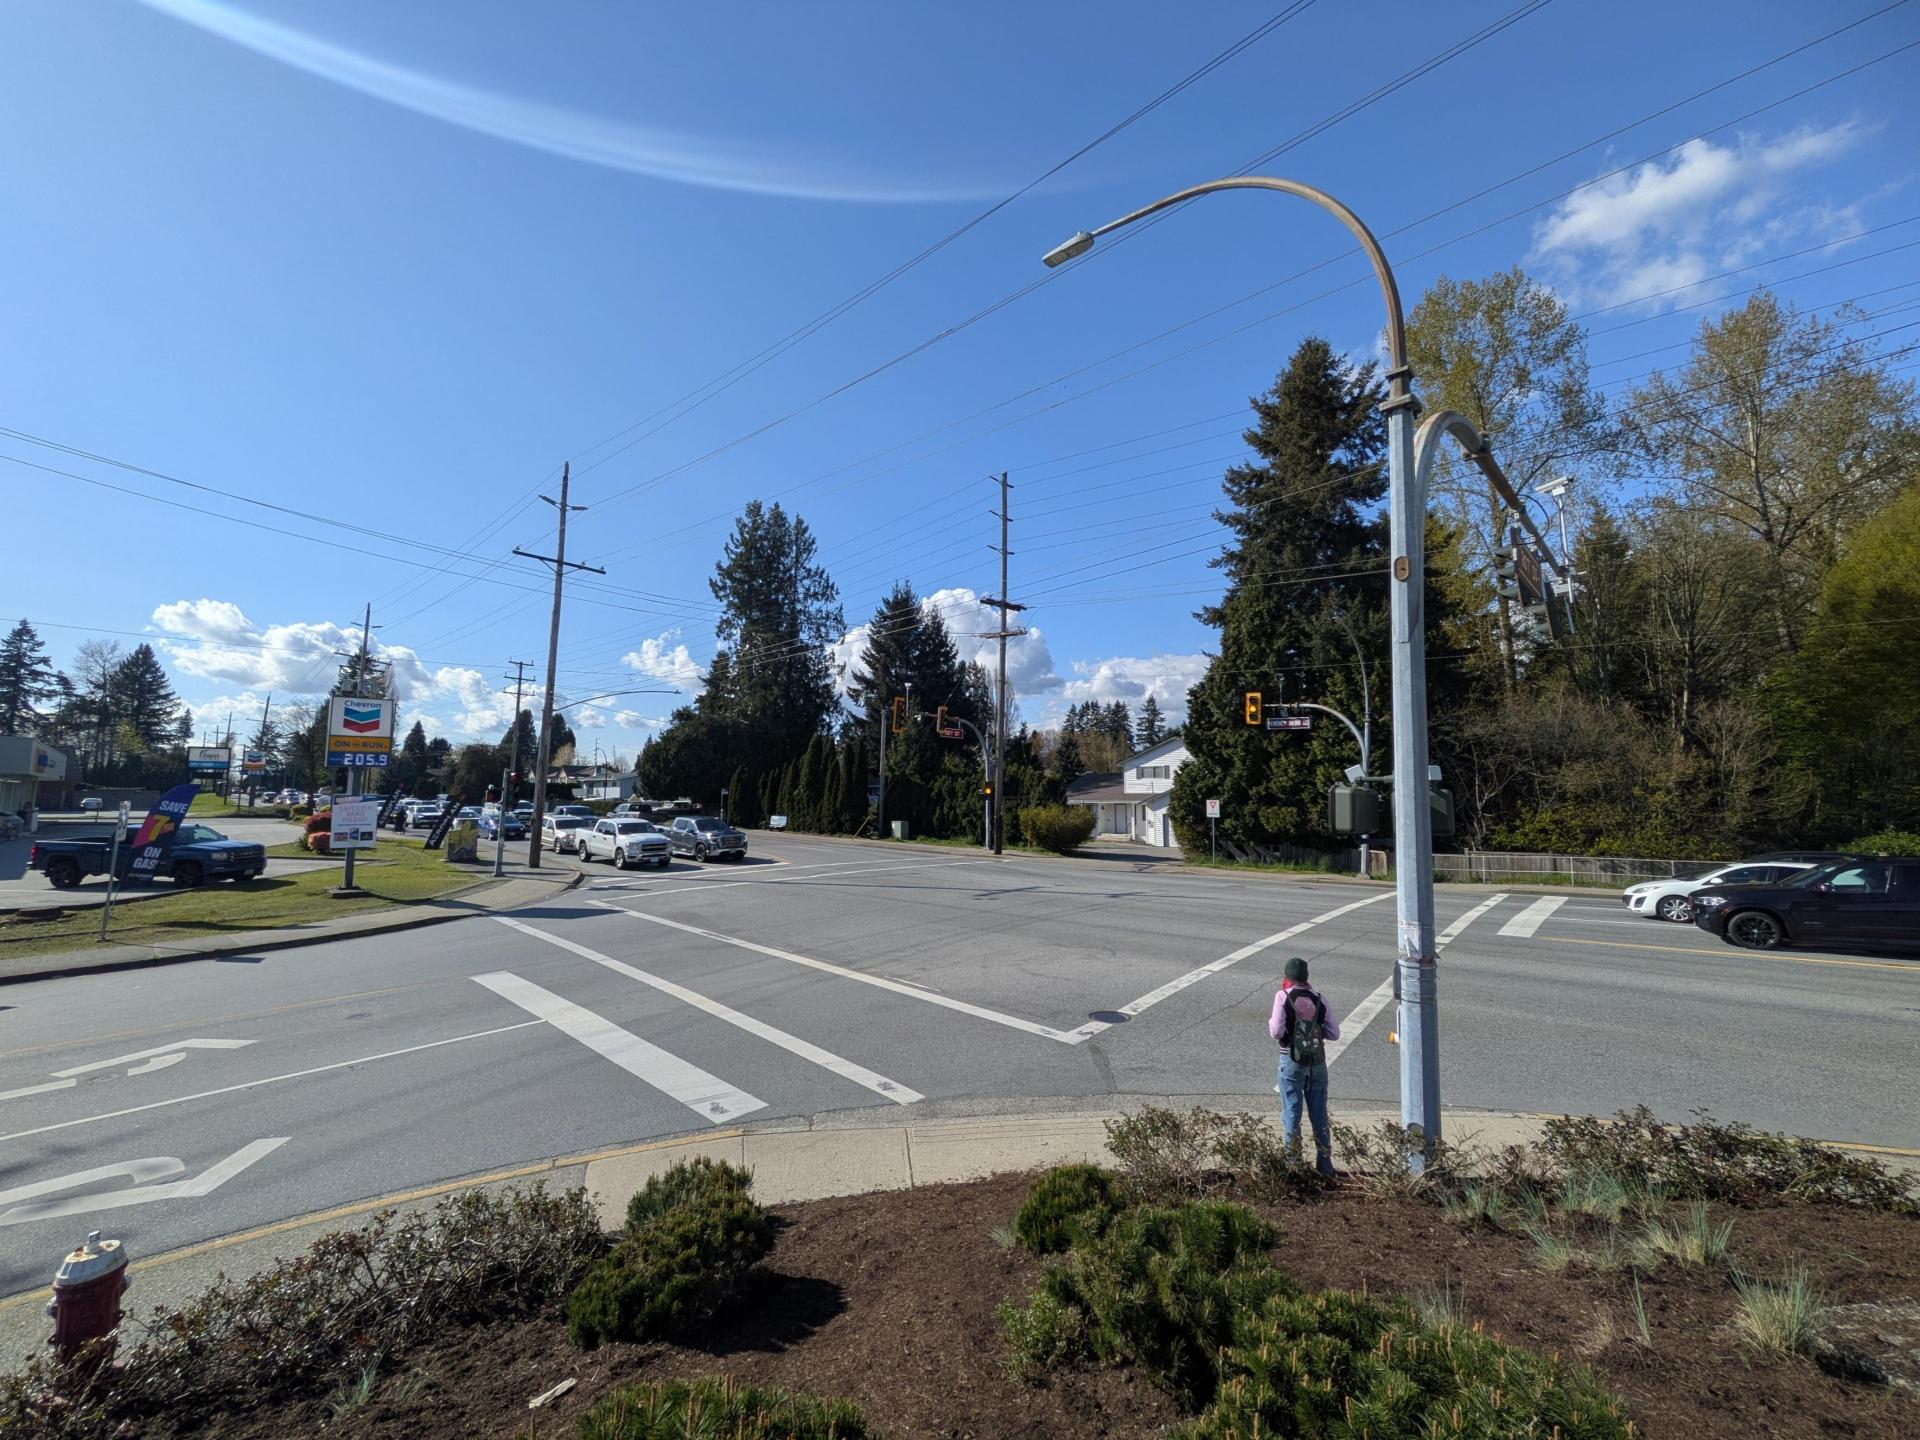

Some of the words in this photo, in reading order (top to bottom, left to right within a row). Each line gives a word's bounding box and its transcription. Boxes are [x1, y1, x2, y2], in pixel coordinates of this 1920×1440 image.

[344, 700, 381, 708] Chevron
[344, 753, 388, 766] 205.9
[160, 800, 188, 813] SAVE
[144, 846, 161, 858] ON
